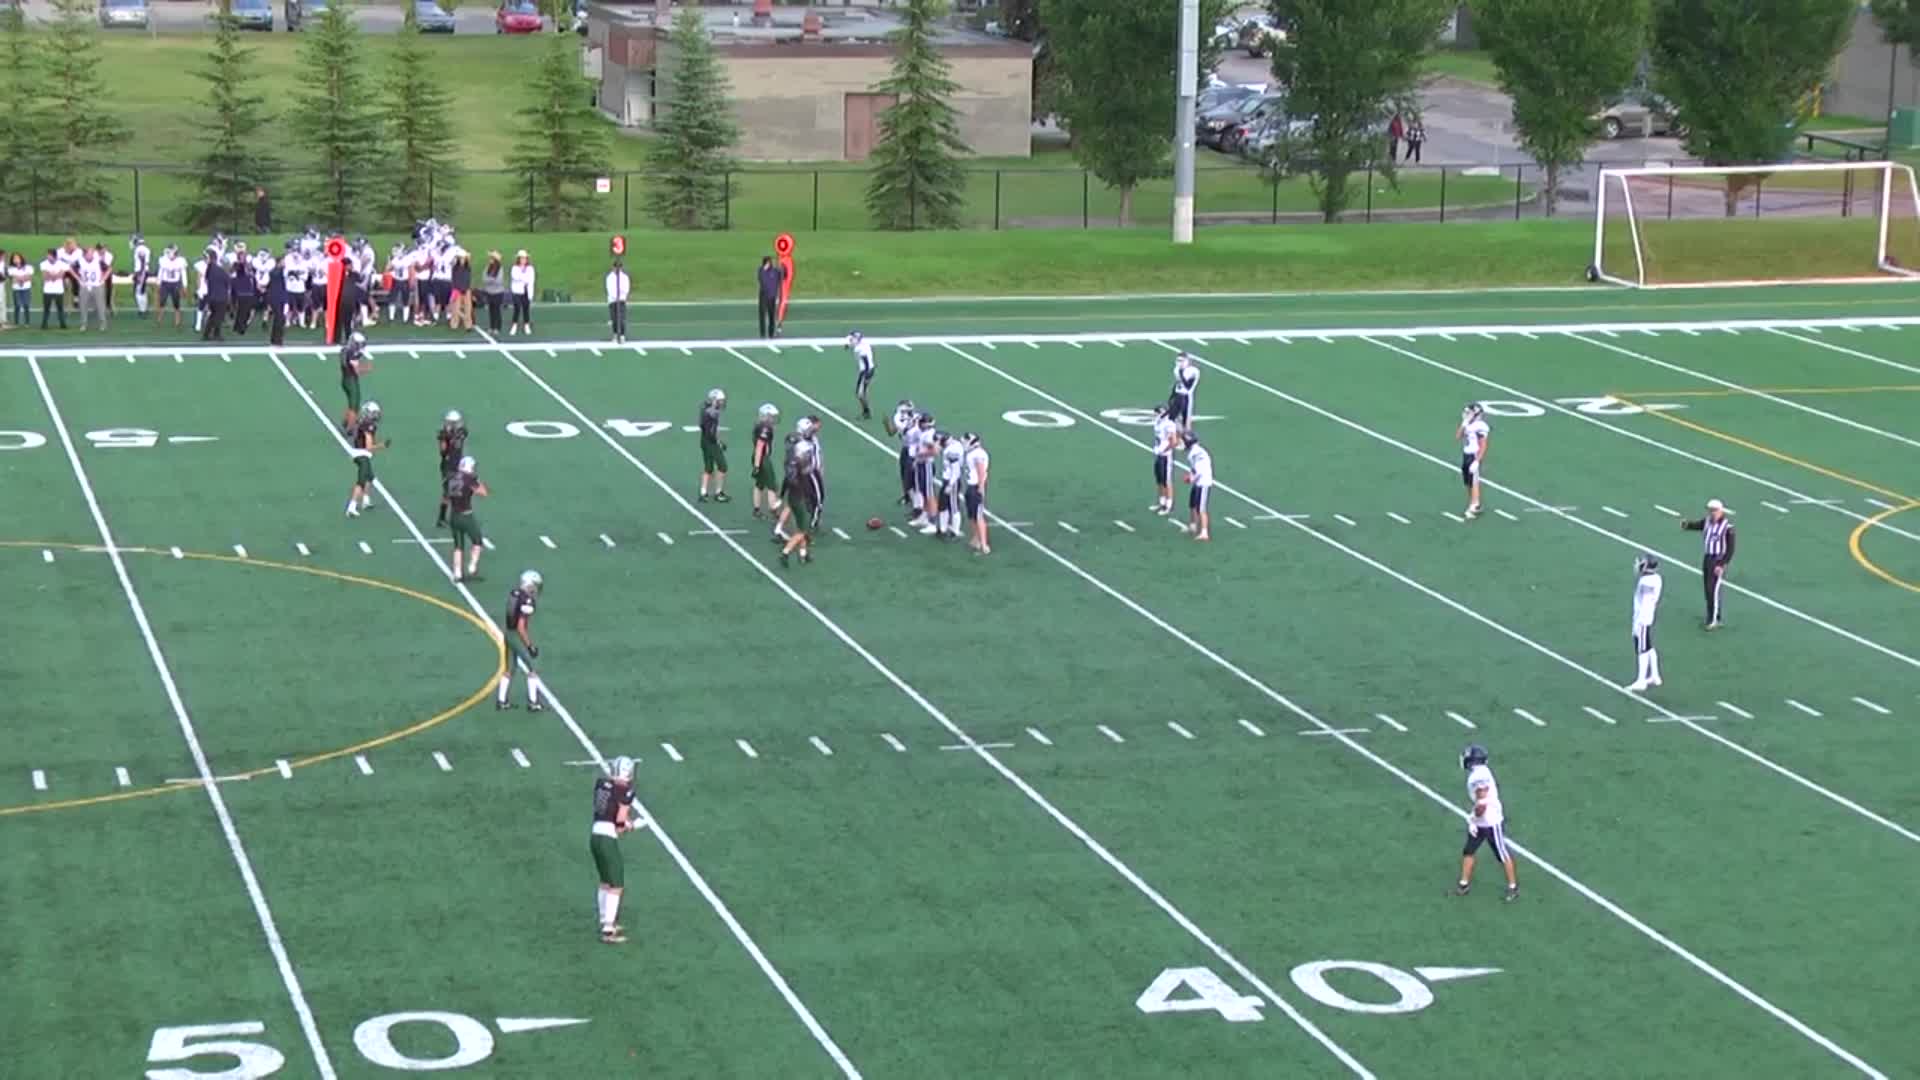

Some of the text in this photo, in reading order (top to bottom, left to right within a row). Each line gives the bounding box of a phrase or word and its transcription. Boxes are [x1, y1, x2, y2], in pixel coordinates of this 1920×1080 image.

[612, 236, 625, 255] 3
[1136, 960, 1435, 1023] 40
[145, 1011, 496, 1080] 50
